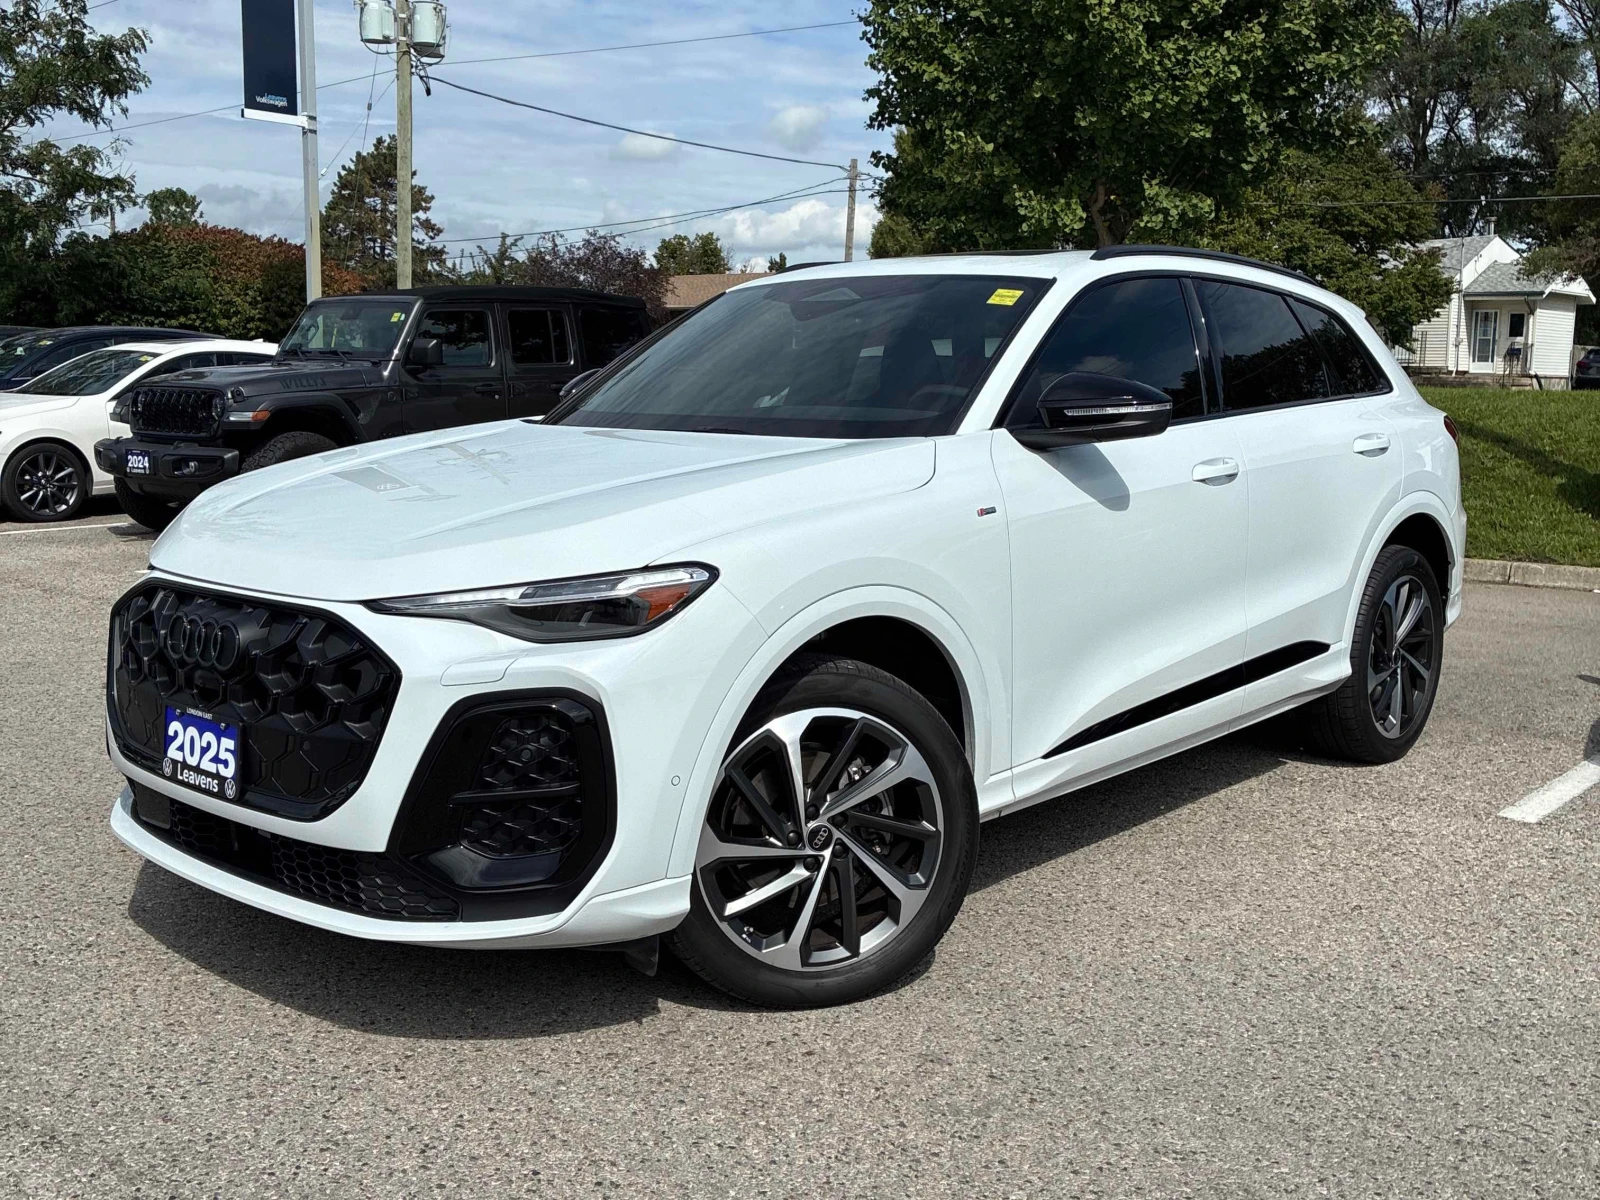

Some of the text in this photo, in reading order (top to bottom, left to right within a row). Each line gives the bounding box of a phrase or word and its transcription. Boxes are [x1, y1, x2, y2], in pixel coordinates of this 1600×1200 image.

[128, 455, 149, 468] 2024
[186, 707, 213, 720] LONDON EAST
[167, 720, 236, 778] 2025
[177, 762, 219, 792] Leavens
